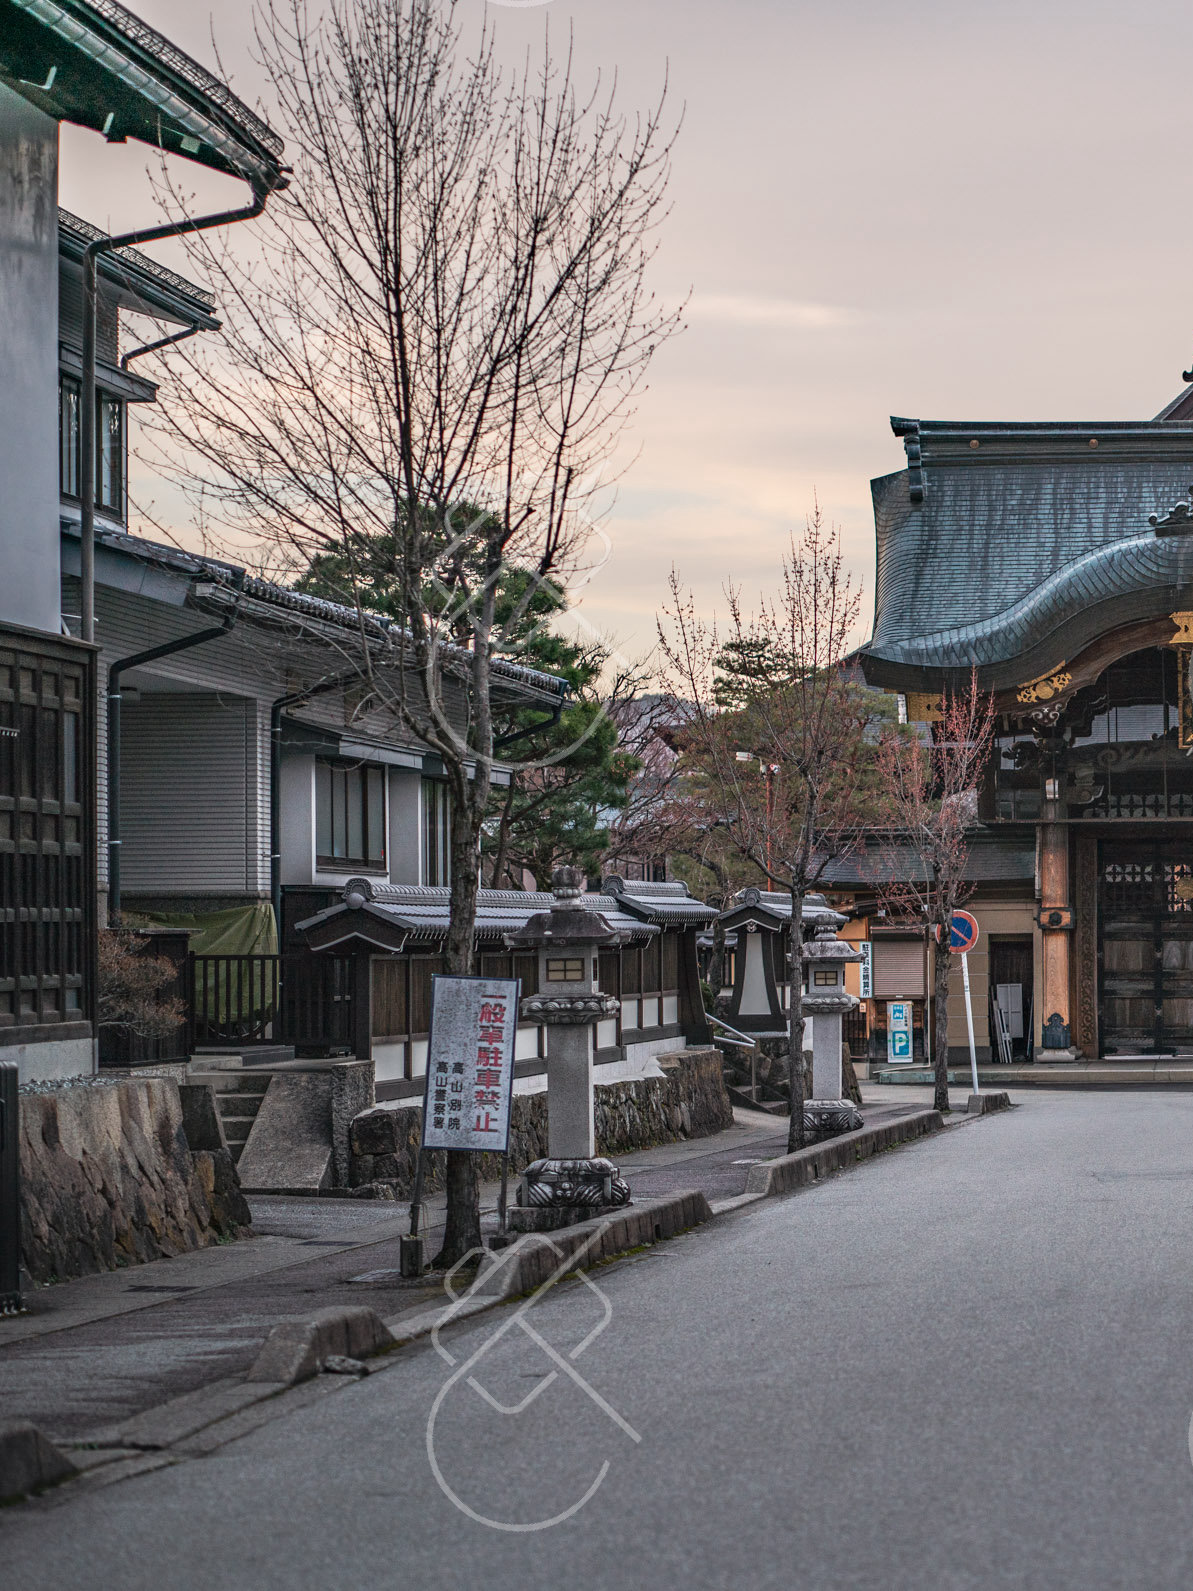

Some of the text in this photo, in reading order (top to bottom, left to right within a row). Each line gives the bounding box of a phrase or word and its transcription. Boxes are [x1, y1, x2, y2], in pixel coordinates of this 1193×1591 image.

[472, 994, 507, 1133] 一般車駐車禁止
[895, 1033, 907, 1054] P
[433, 1061, 449, 1130] 高山警察署
[447, 1061, 464, 1131] 高山別院
